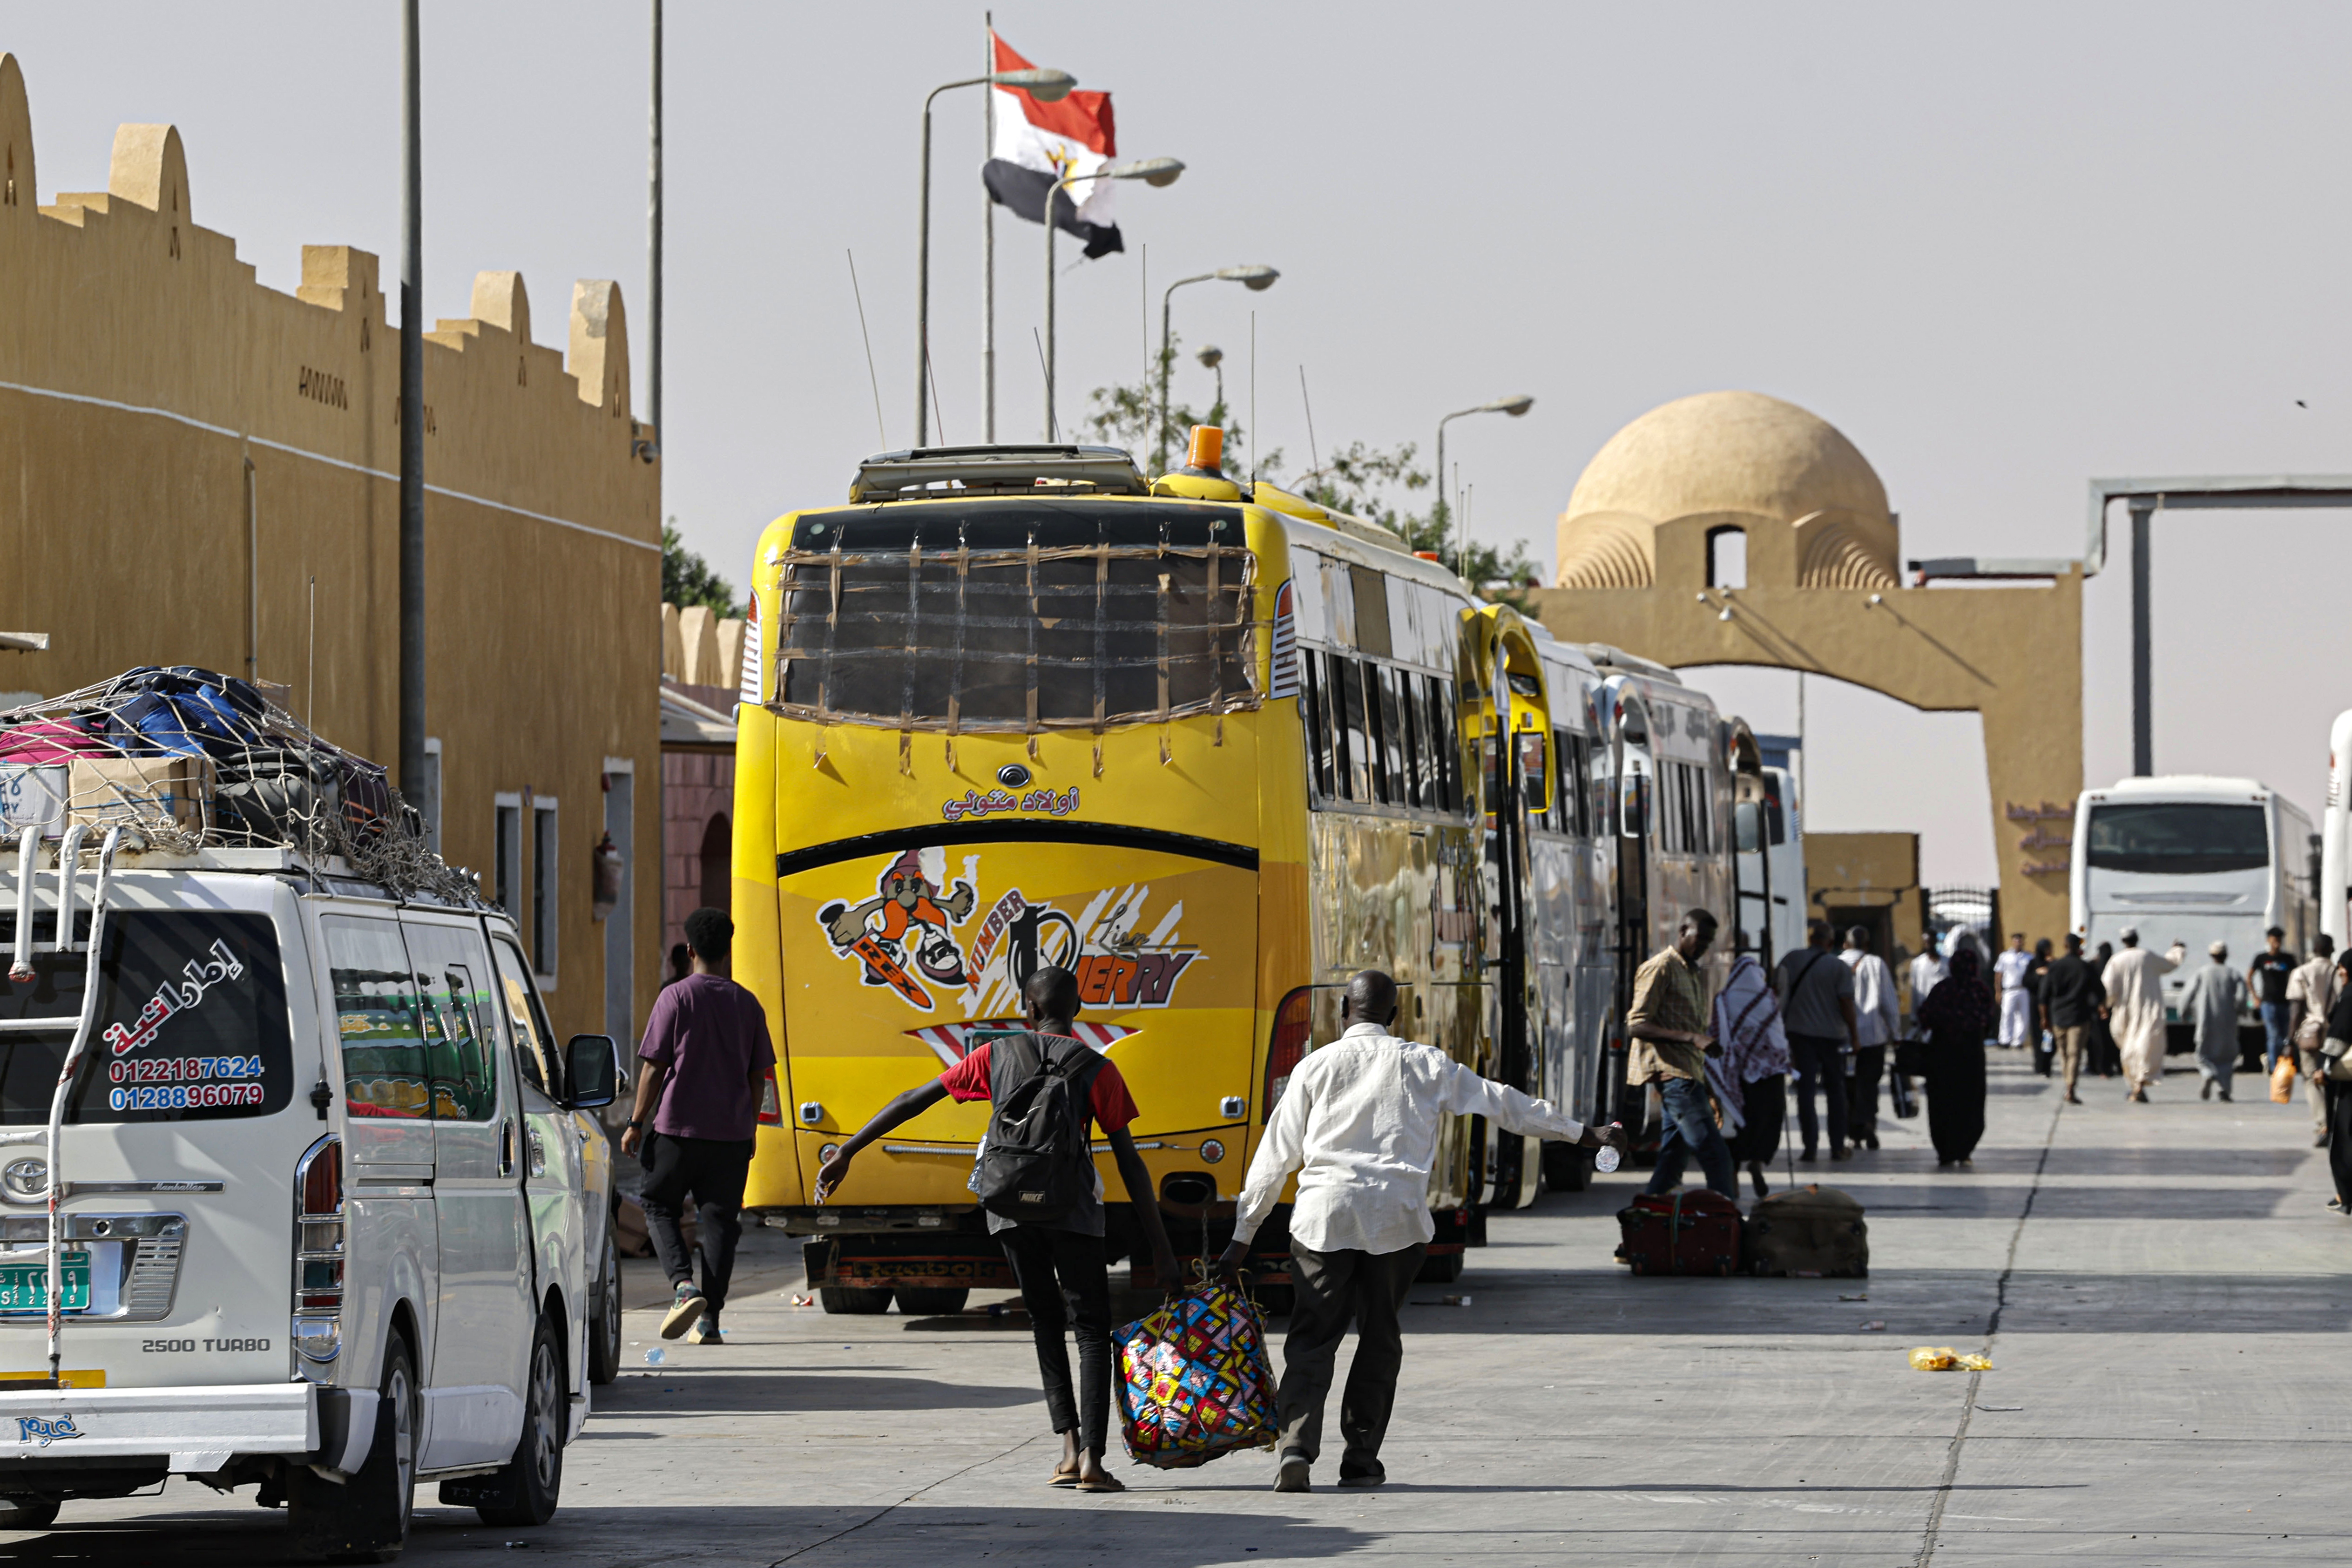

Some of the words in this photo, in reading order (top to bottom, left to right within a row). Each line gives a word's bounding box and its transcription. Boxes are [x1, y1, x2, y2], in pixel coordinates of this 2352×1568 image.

[942, 789, 1018, 821] متولي
[1021, 787, 1080, 816] أولاد
[965, 890, 1026, 996] NUMBER
[858, 941, 919, 997] REX
[102, 938, 244, 1057] إماراتية
[109, 1054, 265, 1083] 0122187624
[109, 1082, 264, 1111] 0128896079
[142, 1339, 196, 1352] 2500
[202, 1338, 270, 1352] TURBO
